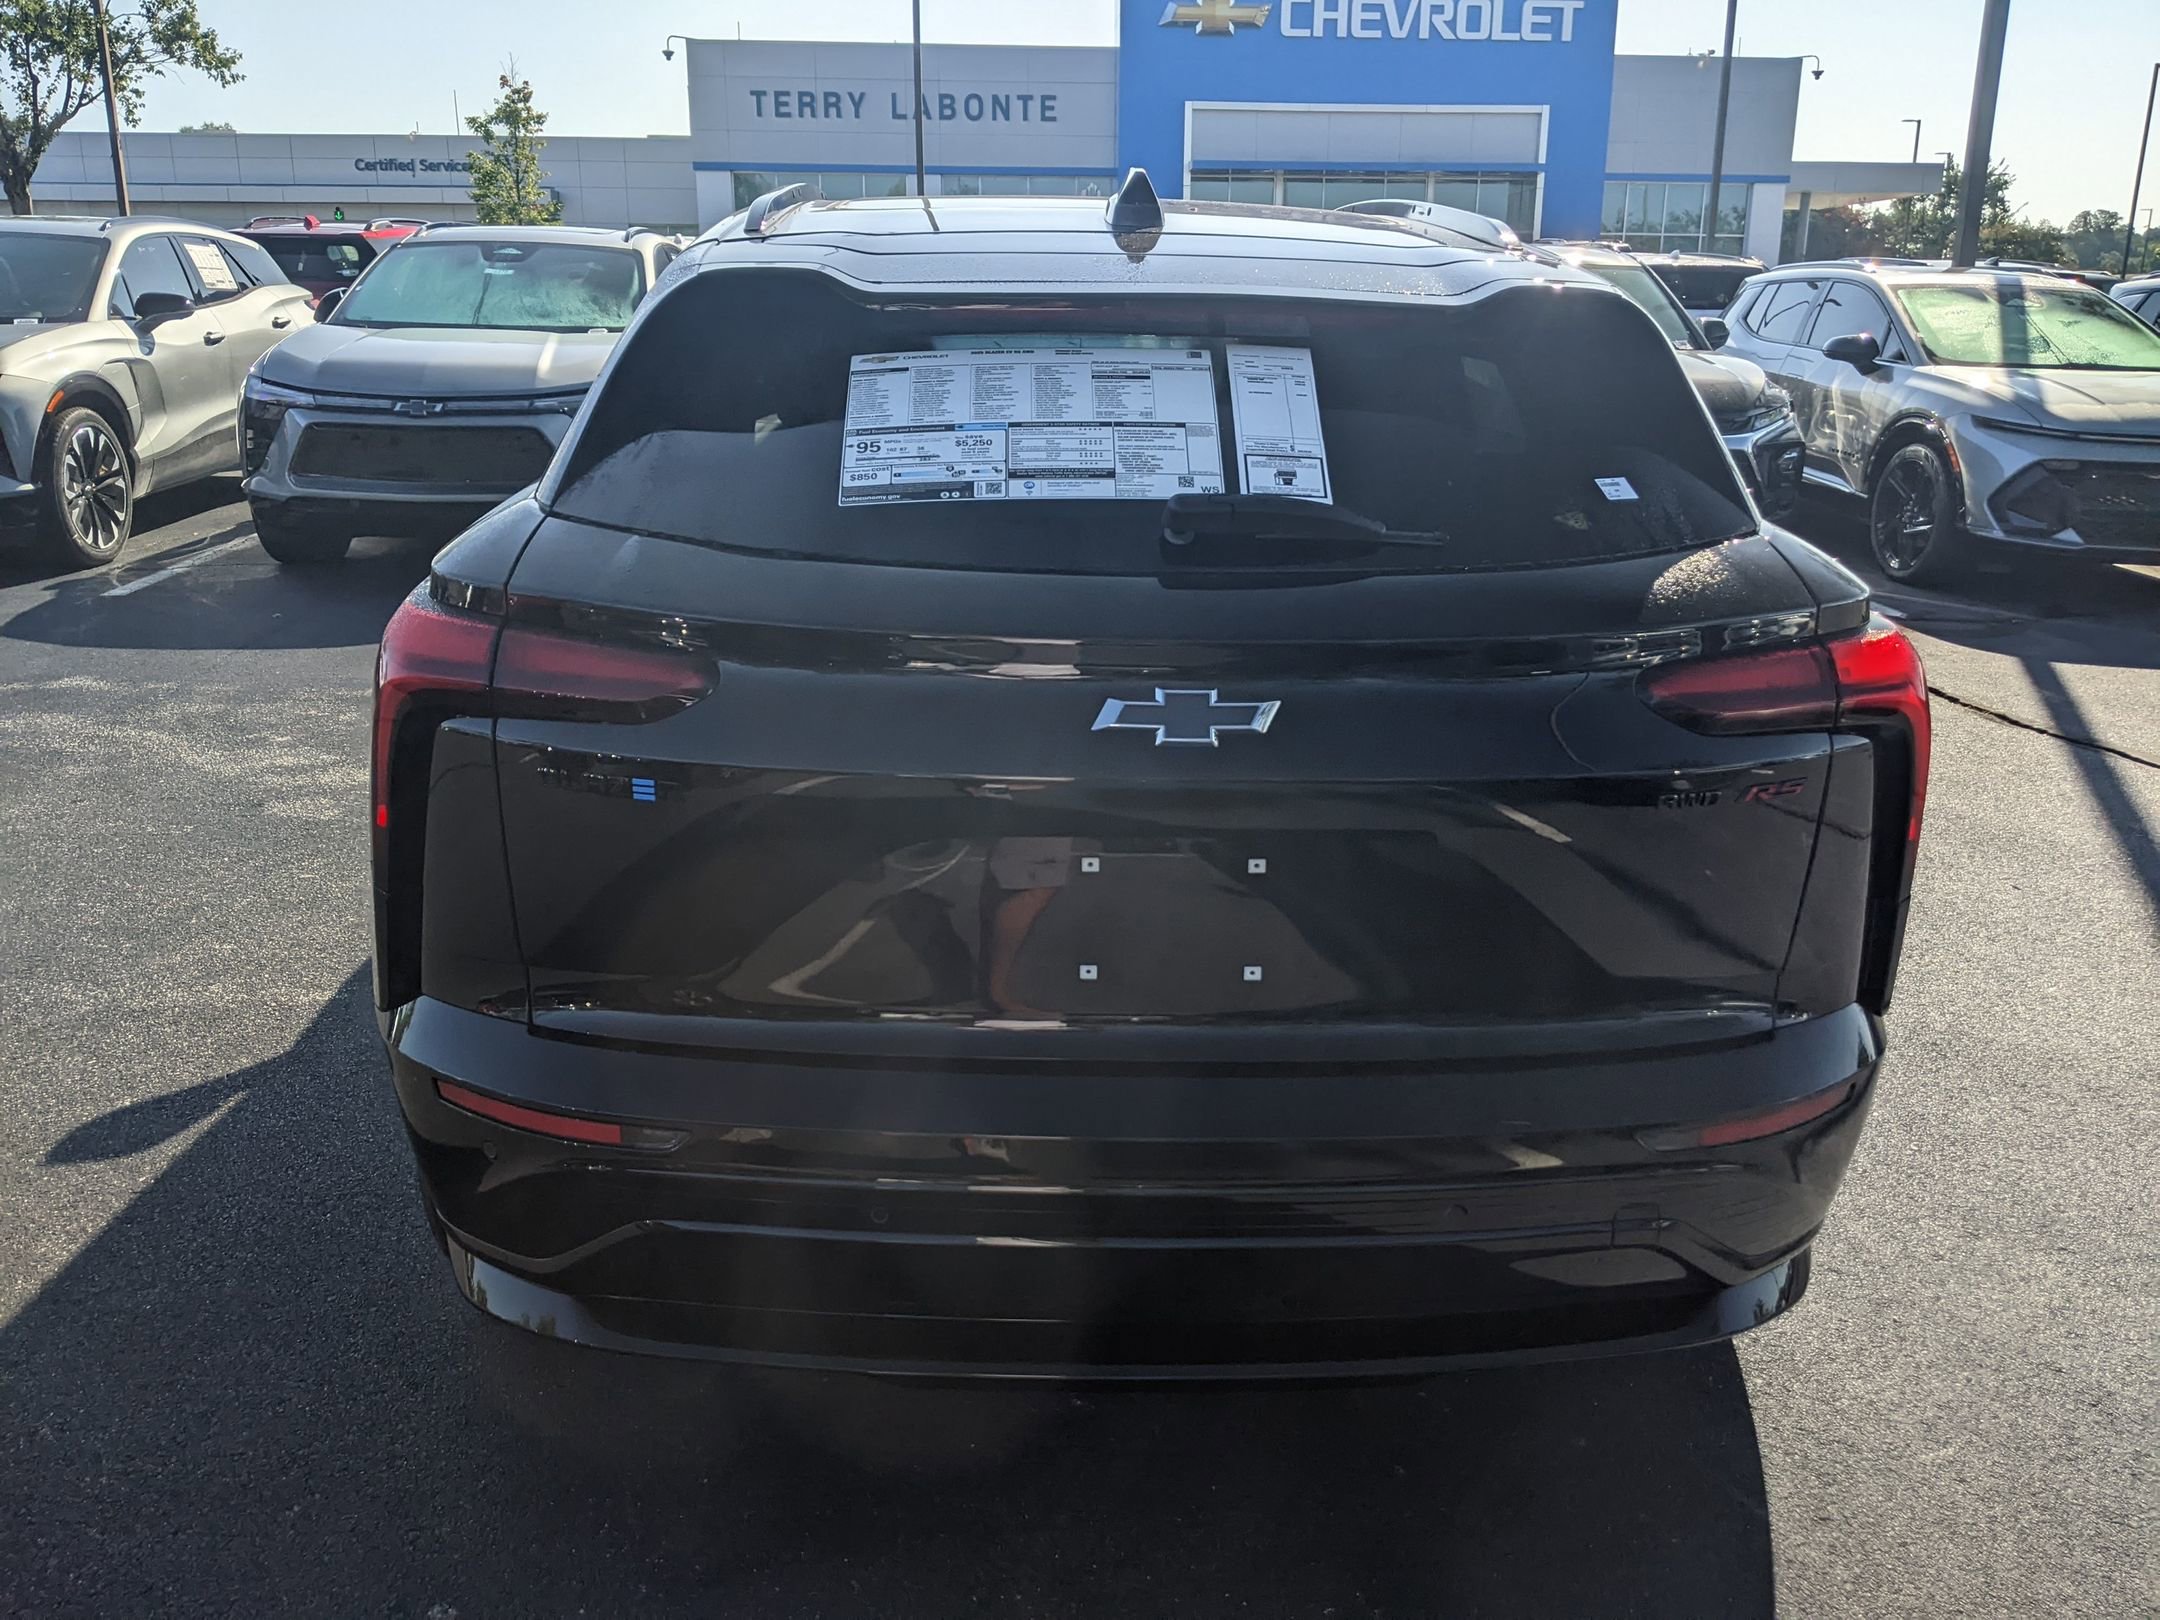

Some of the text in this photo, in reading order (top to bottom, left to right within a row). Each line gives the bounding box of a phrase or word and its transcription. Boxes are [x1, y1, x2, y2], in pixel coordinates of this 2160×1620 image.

[1280, 0, 1585, 43] CHEVROLET
[750, 89, 1058, 123] TERRY LABONTE
[354, 158, 471, 172] Certified Service
[902, 353, 949, 361] CHEVROLET
[856, 440, 882, 454] 95
[955, 438, 993, 448] $5,250
[849, 473, 878, 482] $850
[1200, 485, 1220, 494] WS
[841, 493, 901, 503] fueleconomy.gov
[1742, 777, 1808, 803] RS
